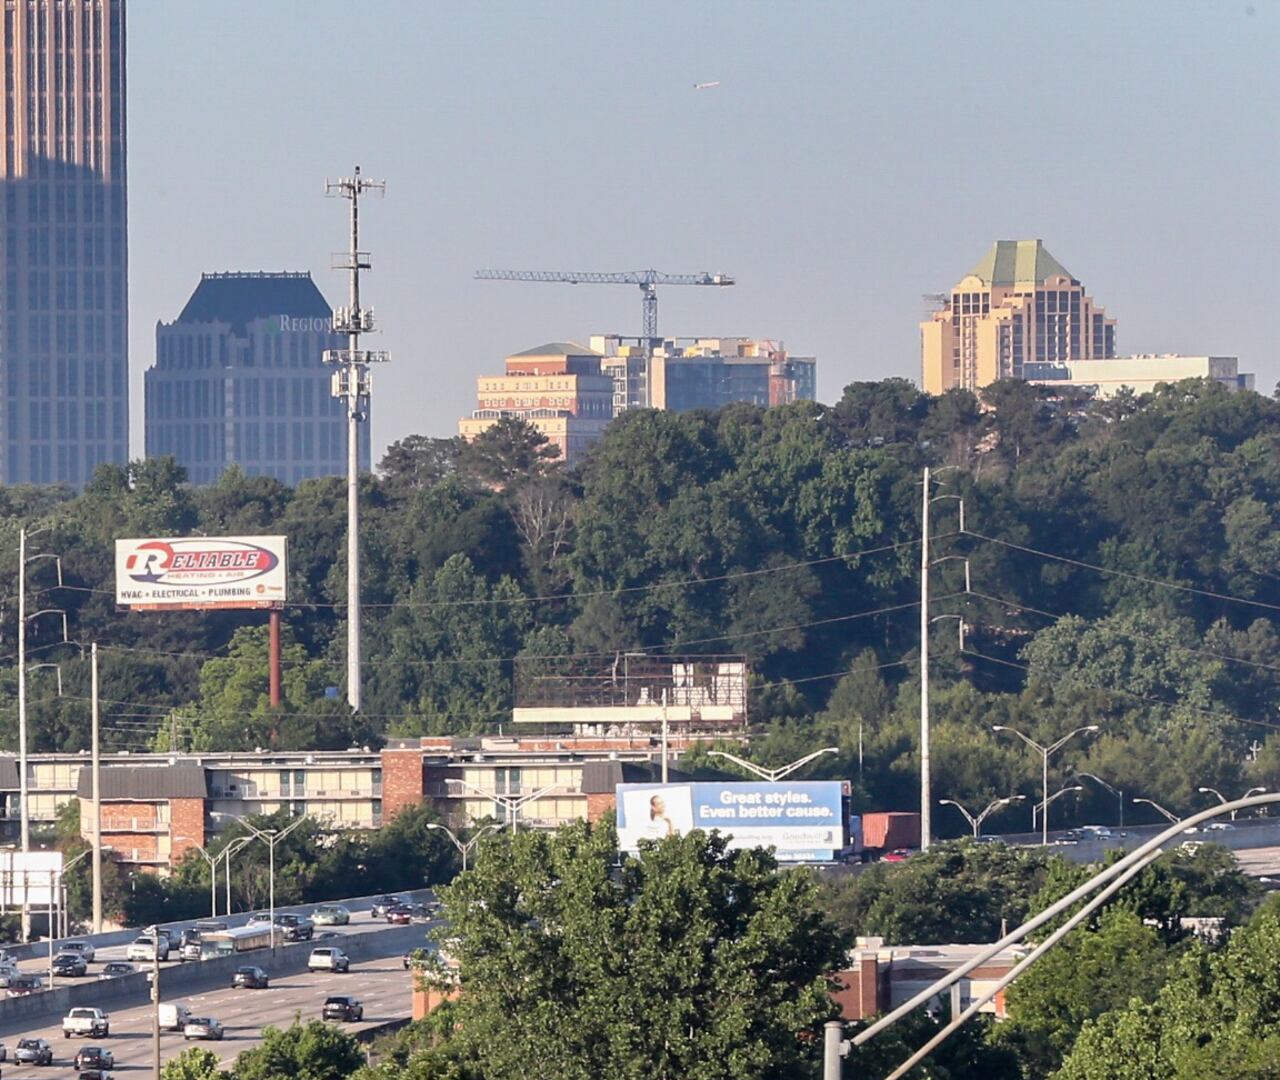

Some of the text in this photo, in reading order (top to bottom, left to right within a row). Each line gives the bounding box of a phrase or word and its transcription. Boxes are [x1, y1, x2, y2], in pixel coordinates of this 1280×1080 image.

[121, 587, 251, 599] HVAC ELECTRICAL PLUMBING
[720, 790, 813, 806] Great styles.
[700, 804, 835, 819] Even better cause.
